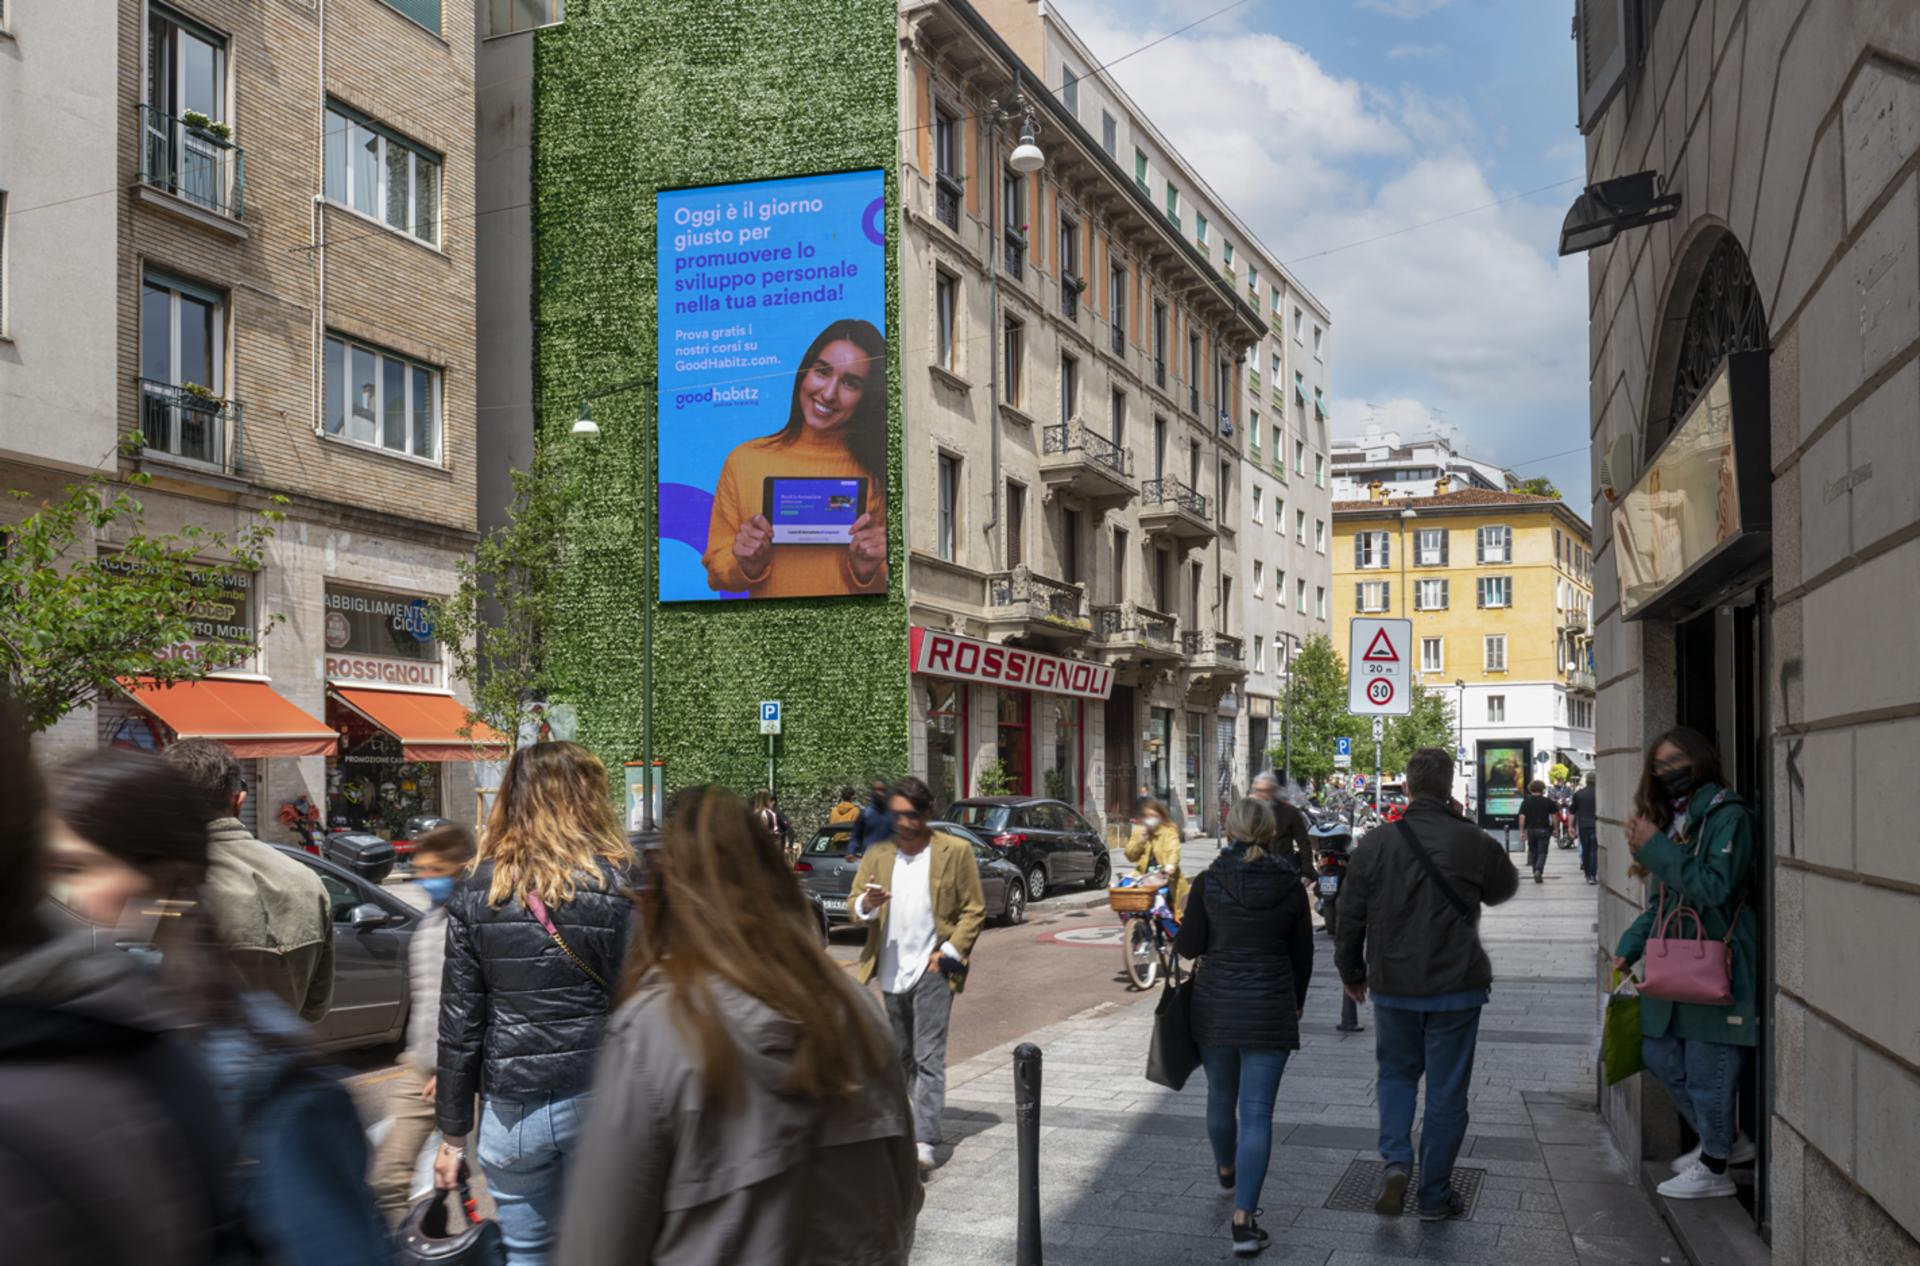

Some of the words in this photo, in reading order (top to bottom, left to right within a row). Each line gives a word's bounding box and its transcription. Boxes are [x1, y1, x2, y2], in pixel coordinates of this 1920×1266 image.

[674, 205, 721, 228] Oggi
[726, 202, 738, 220] è
[743, 200, 754, 218] il
[759, 197, 823, 221] giorno
[674, 228, 734, 251] giusto
[739, 225, 771, 245] per
[675, 244, 793, 274] promuovere
[797, 241, 816, 259] lo
[674, 269, 756, 293] sviluppo
[761, 260, 858, 289] personale
[675, 294, 720, 314] nella
[725, 292, 757, 309] tua
[761, 284, 844, 308] azienda!
[675, 330, 709, 341] Prova
[711, 325, 746, 343] gratis
[675, 341, 709, 356] nostri
[712, 339, 741, 353] corsi
[743, 341, 758, 352] su
[675, 355, 781, 372] GoodHabitz.com.
[676, 386, 759, 410] goodhabitz
[393, 617, 428, 633] CICLO
[325, 657, 434, 685] ROSSIGNOLI
[927, 636, 1109, 695] ROSSIGNOLI
[1369, 664, 1383, 673] 20
[1372, 685, 1388, 698] 30
[765, 704, 776, 720] P
[1339, 739, 1347, 754] P
[345, 755, 389, 764] PROMOZIONE
